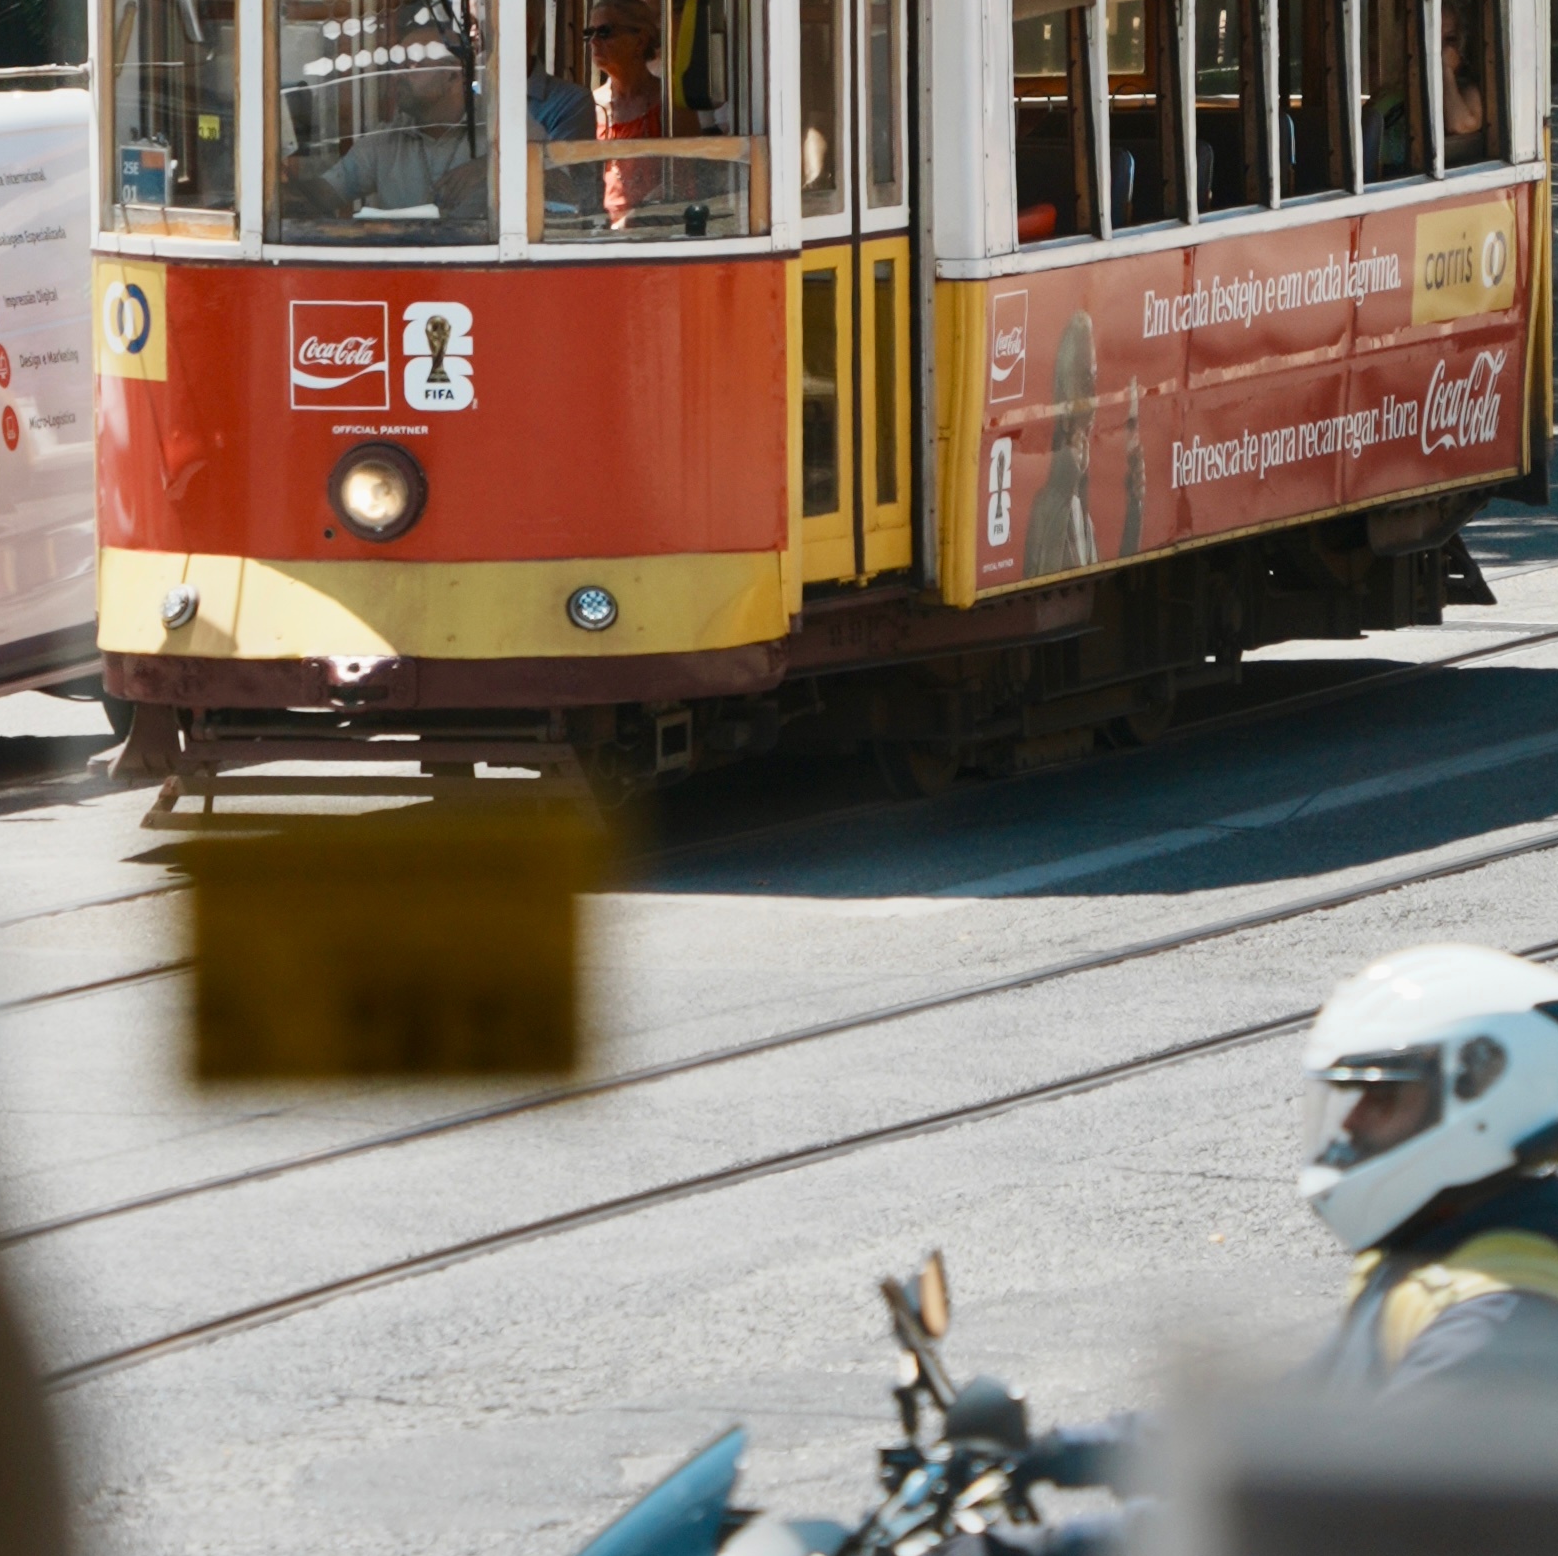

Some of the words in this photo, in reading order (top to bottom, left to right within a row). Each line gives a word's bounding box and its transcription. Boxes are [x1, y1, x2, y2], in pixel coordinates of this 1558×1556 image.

[123, 161, 139, 175] 25E
[122, 185, 138, 204] 01
[1424, 234, 1473, 291] carris
[1142, 289, 1171, 338] Em
[1172, 279, 1209, 335] cada
[1209, 269, 1263, 329] festejo
[1264, 284, 1275, 315] e
[1276, 277, 1302, 311] em
[1303, 253, 1341, 306] cada
[1342, 246, 1402, 307] lágrima.
[299, 335, 379, 366] Coca-Cola
[19, 351, 42, 370] Design
[424, 389, 455, 400] FIFA
[332, 425, 378, 435] OFFICIAL
[380, 425, 429, 435] PARTNER
[1171, 428, 1258, 489] Refresca-te
[1260, 424, 1296, 480] para
[1297, 406, 1380, 459] recarregar.
[1382, 393, 1418, 443] Hora
